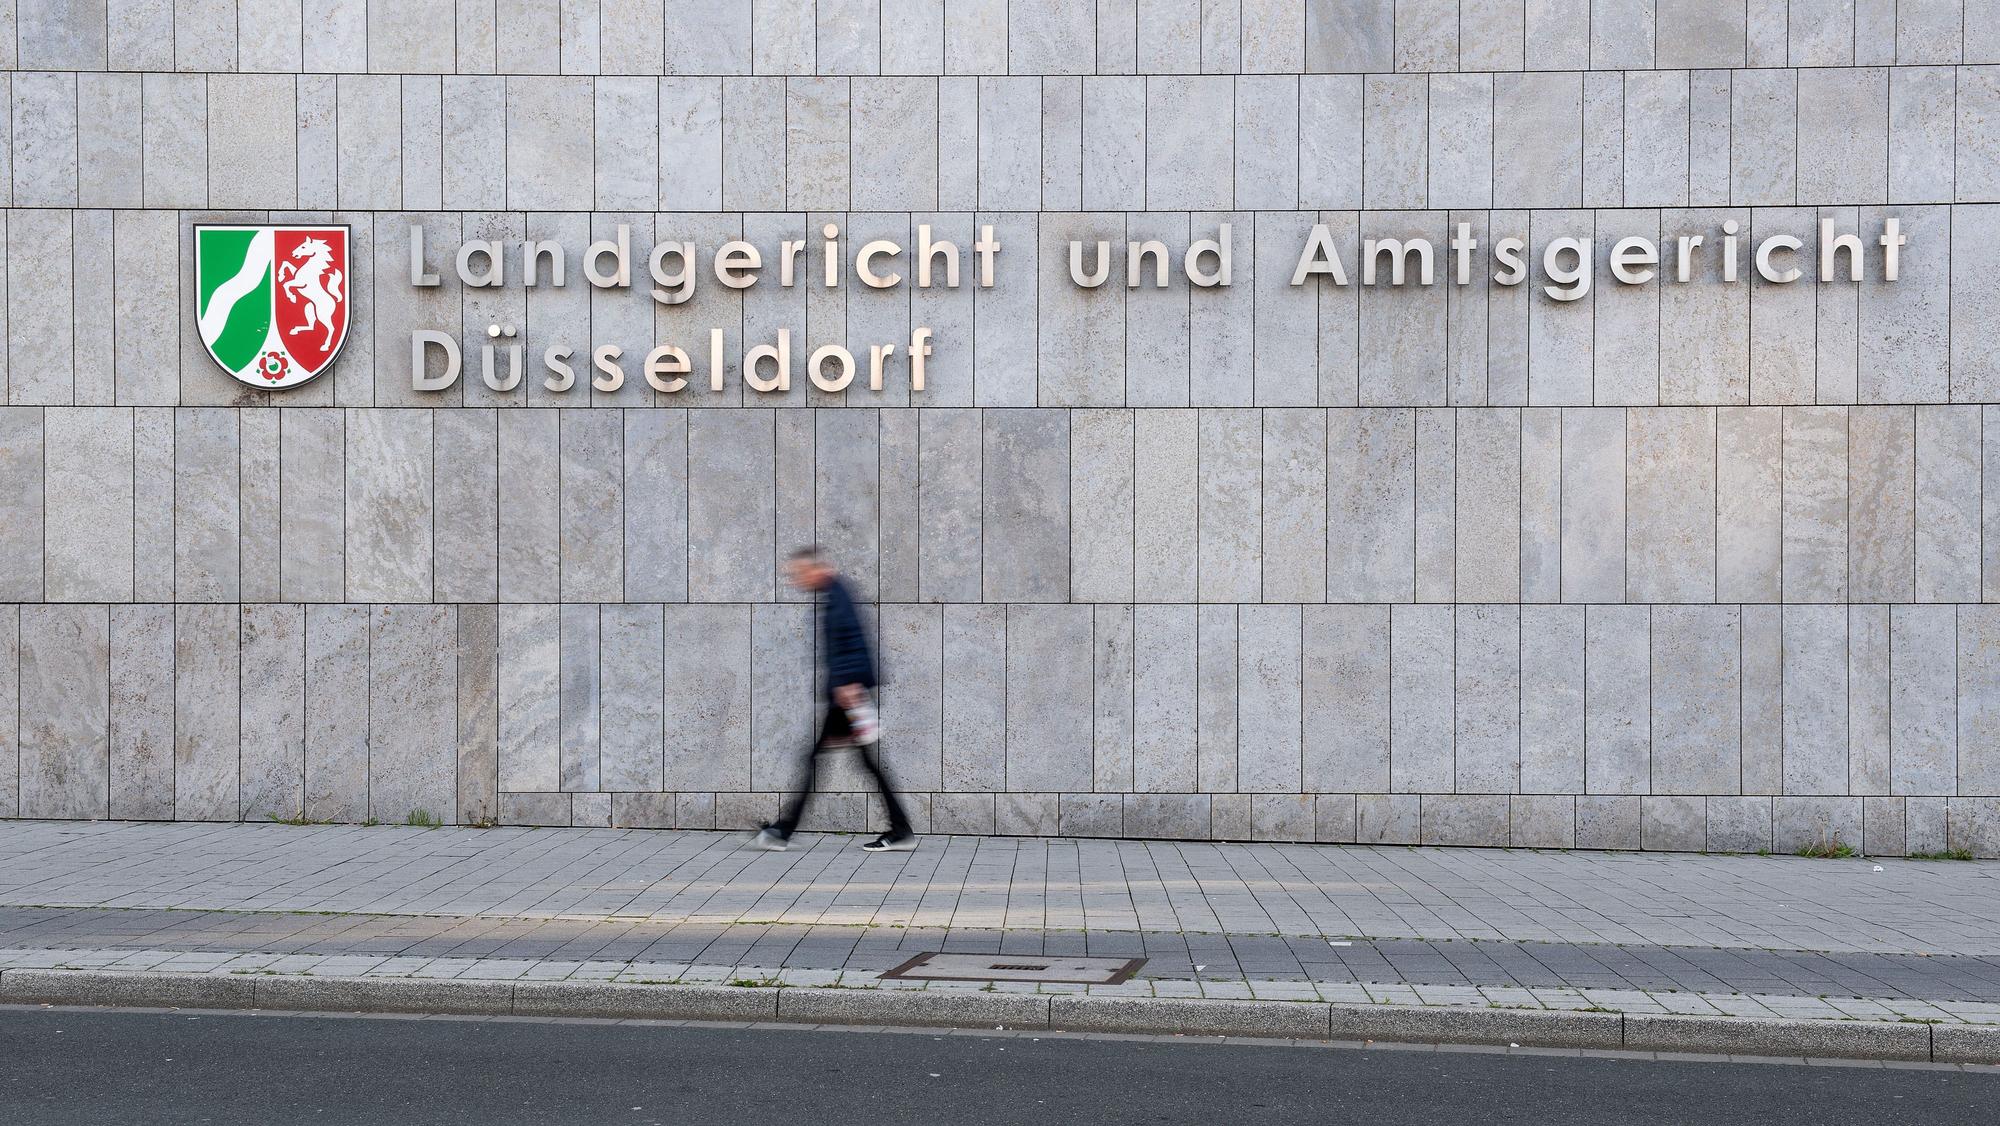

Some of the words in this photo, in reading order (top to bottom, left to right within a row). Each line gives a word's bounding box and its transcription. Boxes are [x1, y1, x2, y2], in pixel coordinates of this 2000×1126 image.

[410, 223, 1002, 305] Landgericht
[1068, 222, 1233, 288] und
[1290, 217, 1907, 302] Amtsgericht
[411, 324, 933, 393] Düsseldorf
